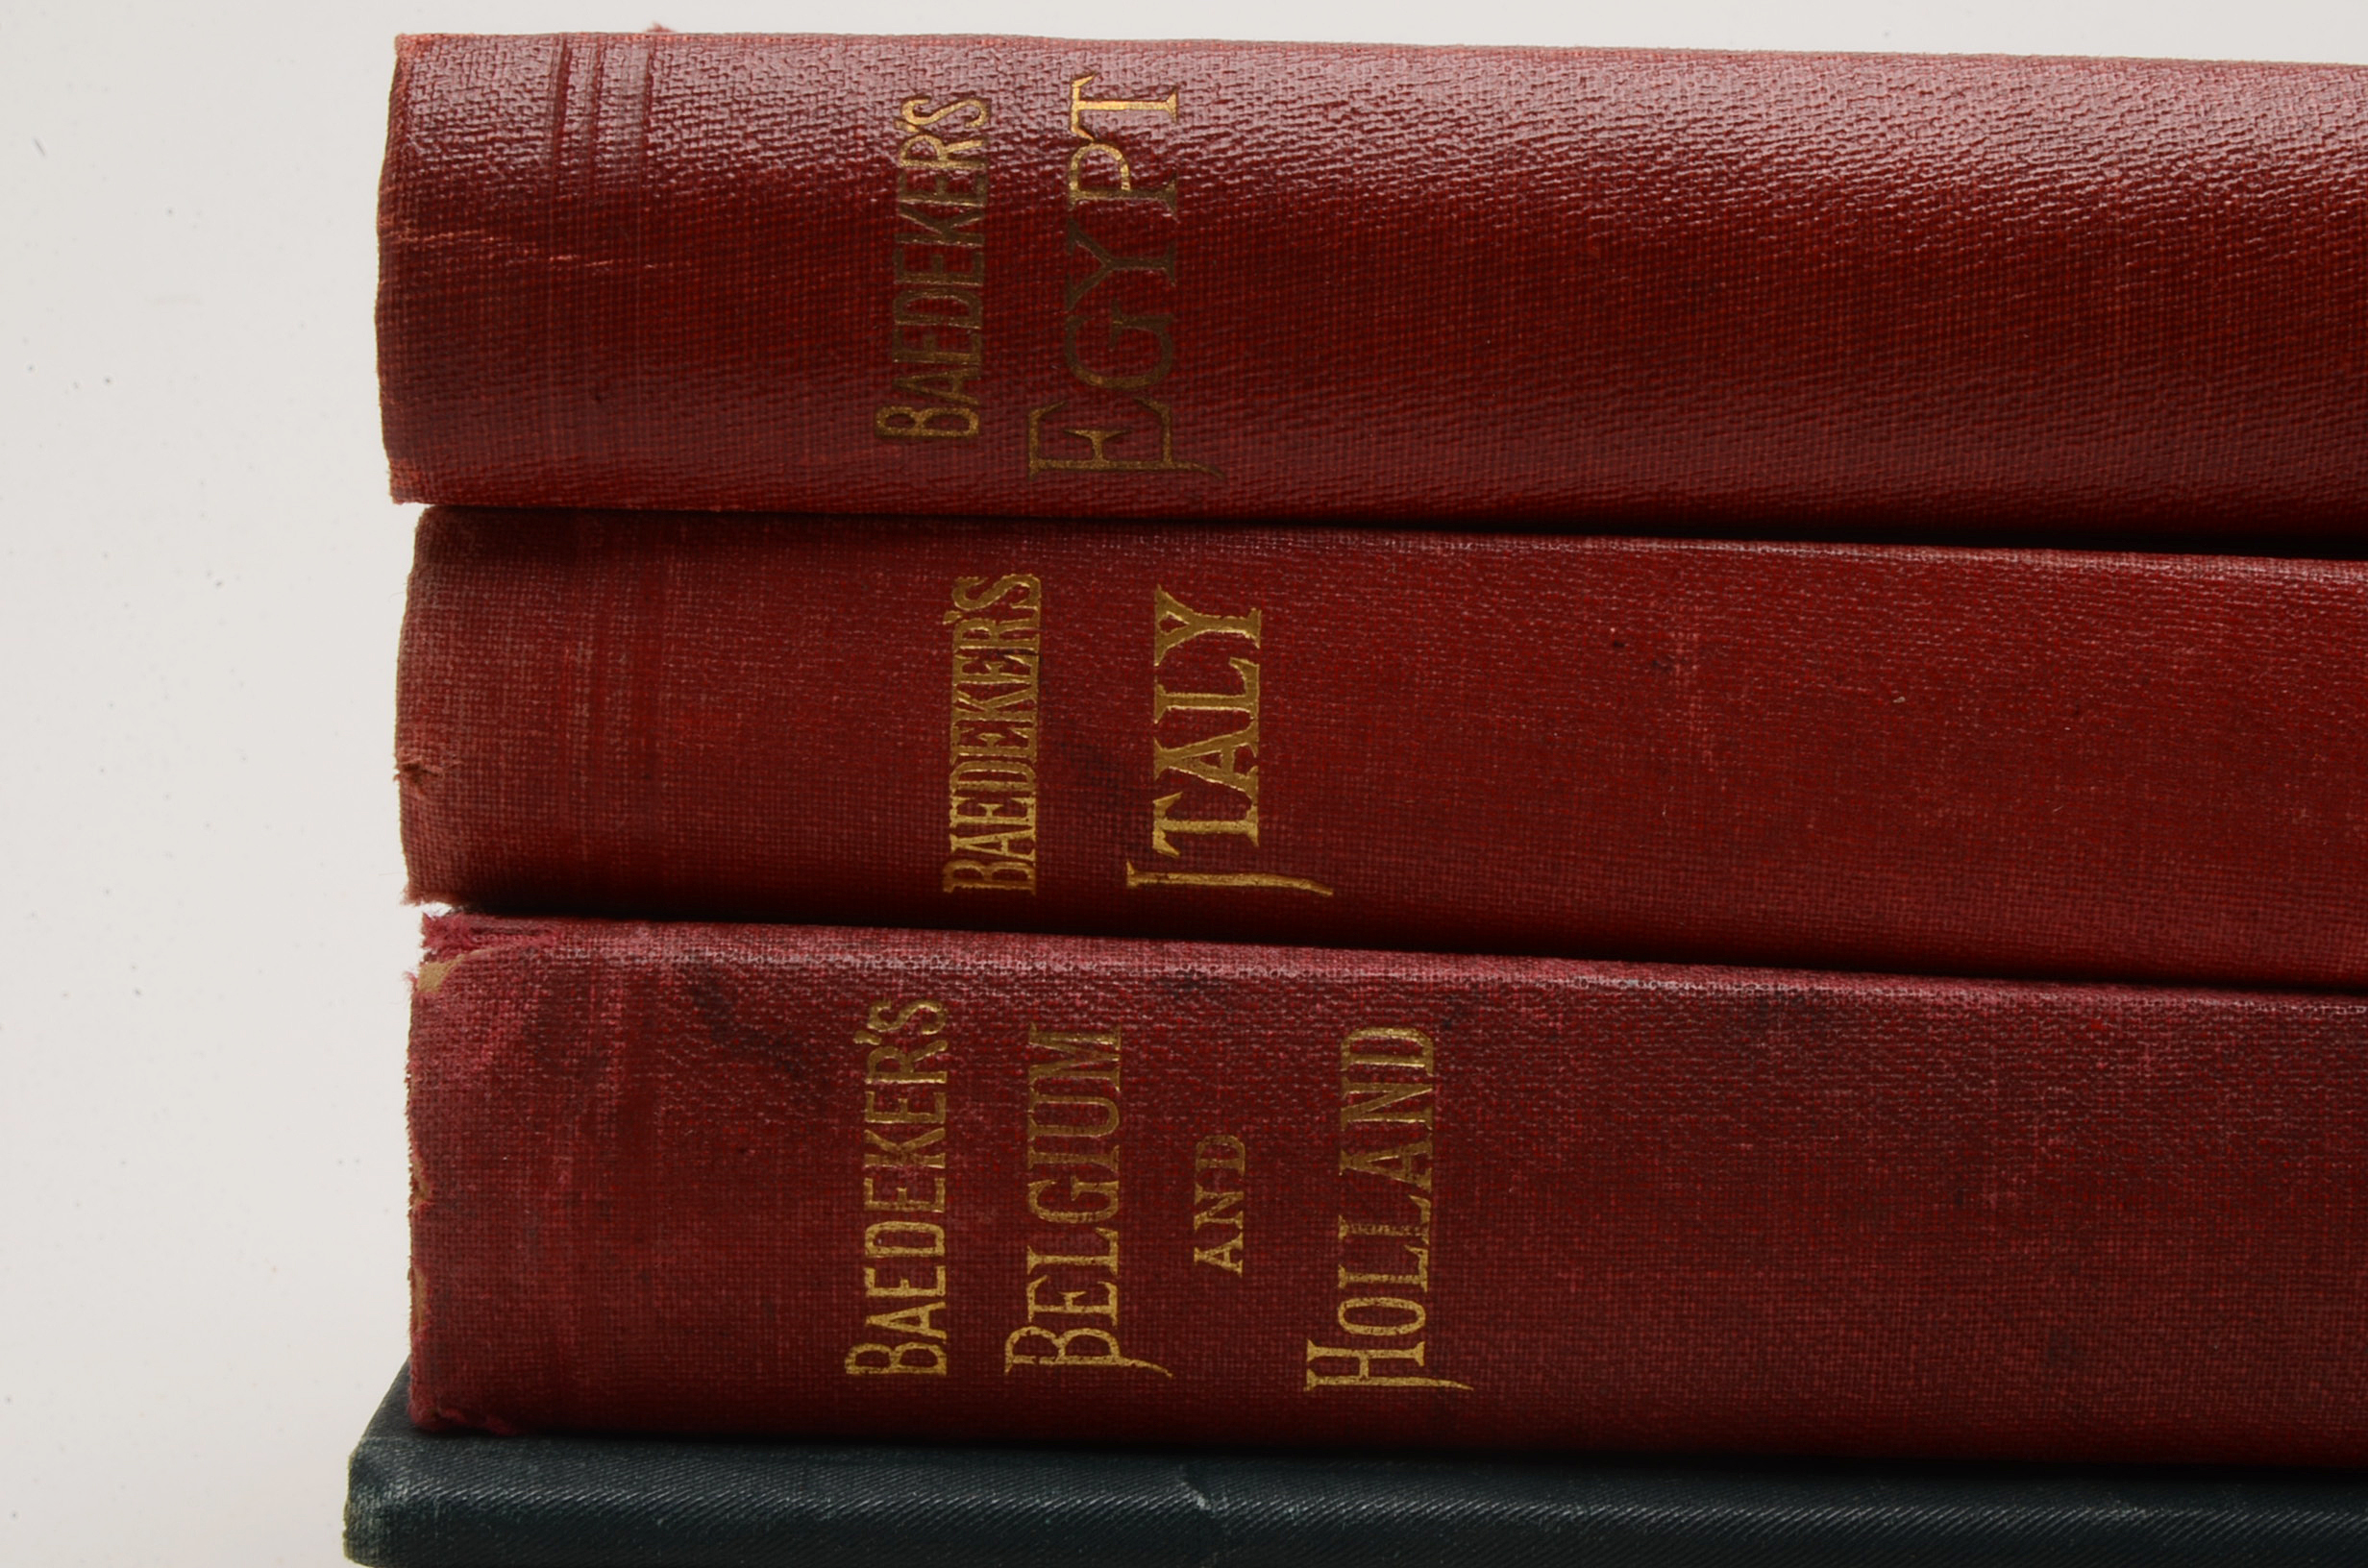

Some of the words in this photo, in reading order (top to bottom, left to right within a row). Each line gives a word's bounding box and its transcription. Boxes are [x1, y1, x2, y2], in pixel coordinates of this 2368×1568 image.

[875, 96, 989, 440] BAEDEKER'S
[1027, 72, 1226, 479] EGYPT
[943, 573, 1041, 894] BAEDEKER'S
[1126, 584, 1333, 896] ITALY
[844, 998, 948, 1376] BAEDEKER'S
[1004, 1022, 1172, 1378] BELGIUM
[1194, 1134, 1246, 1277] AND
[1302, 1026, 1473, 1391] HOLLAND
